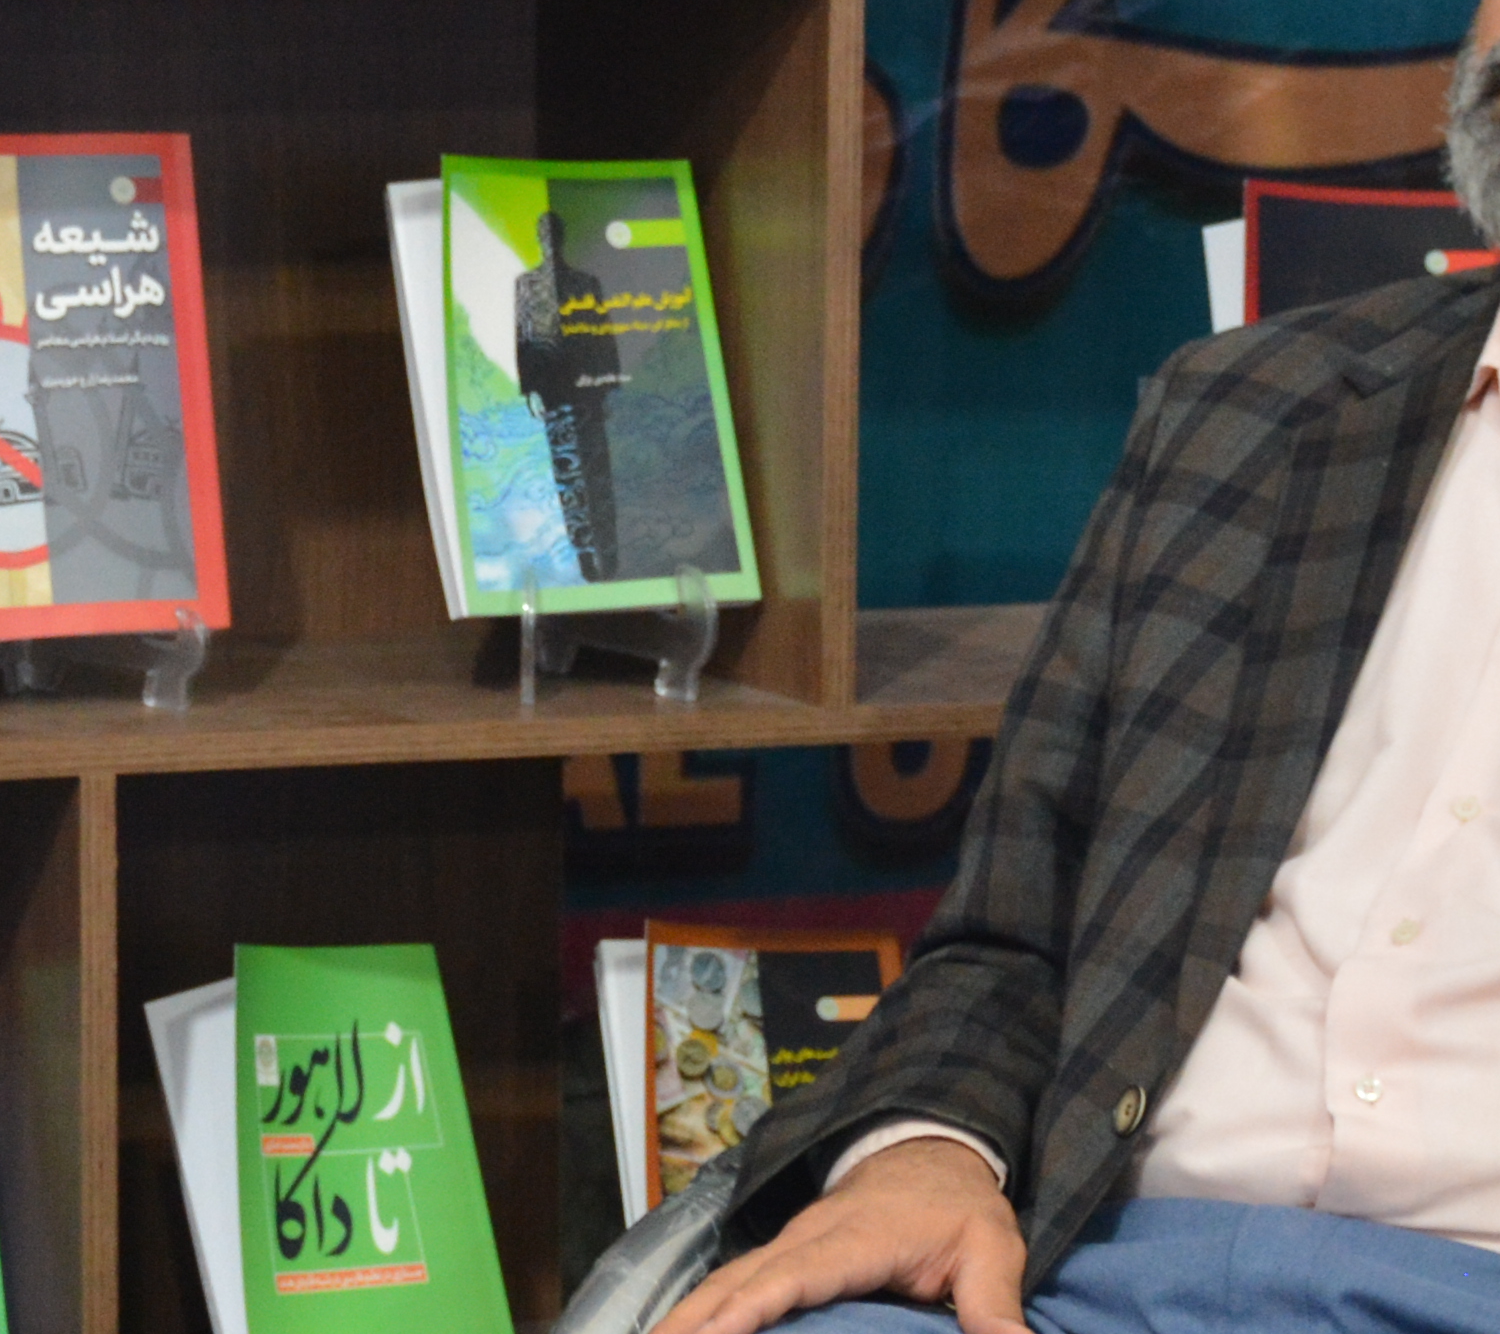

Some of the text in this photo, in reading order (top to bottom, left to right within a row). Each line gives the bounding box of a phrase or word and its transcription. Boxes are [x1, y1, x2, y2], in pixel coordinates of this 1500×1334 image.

[33, 209, 160, 265] شیعه
[35, 265, 166, 321] هراسی
[262, 1019, 426, 1125] از لاهور
[275, 1146, 412, 1260] تا داکا
